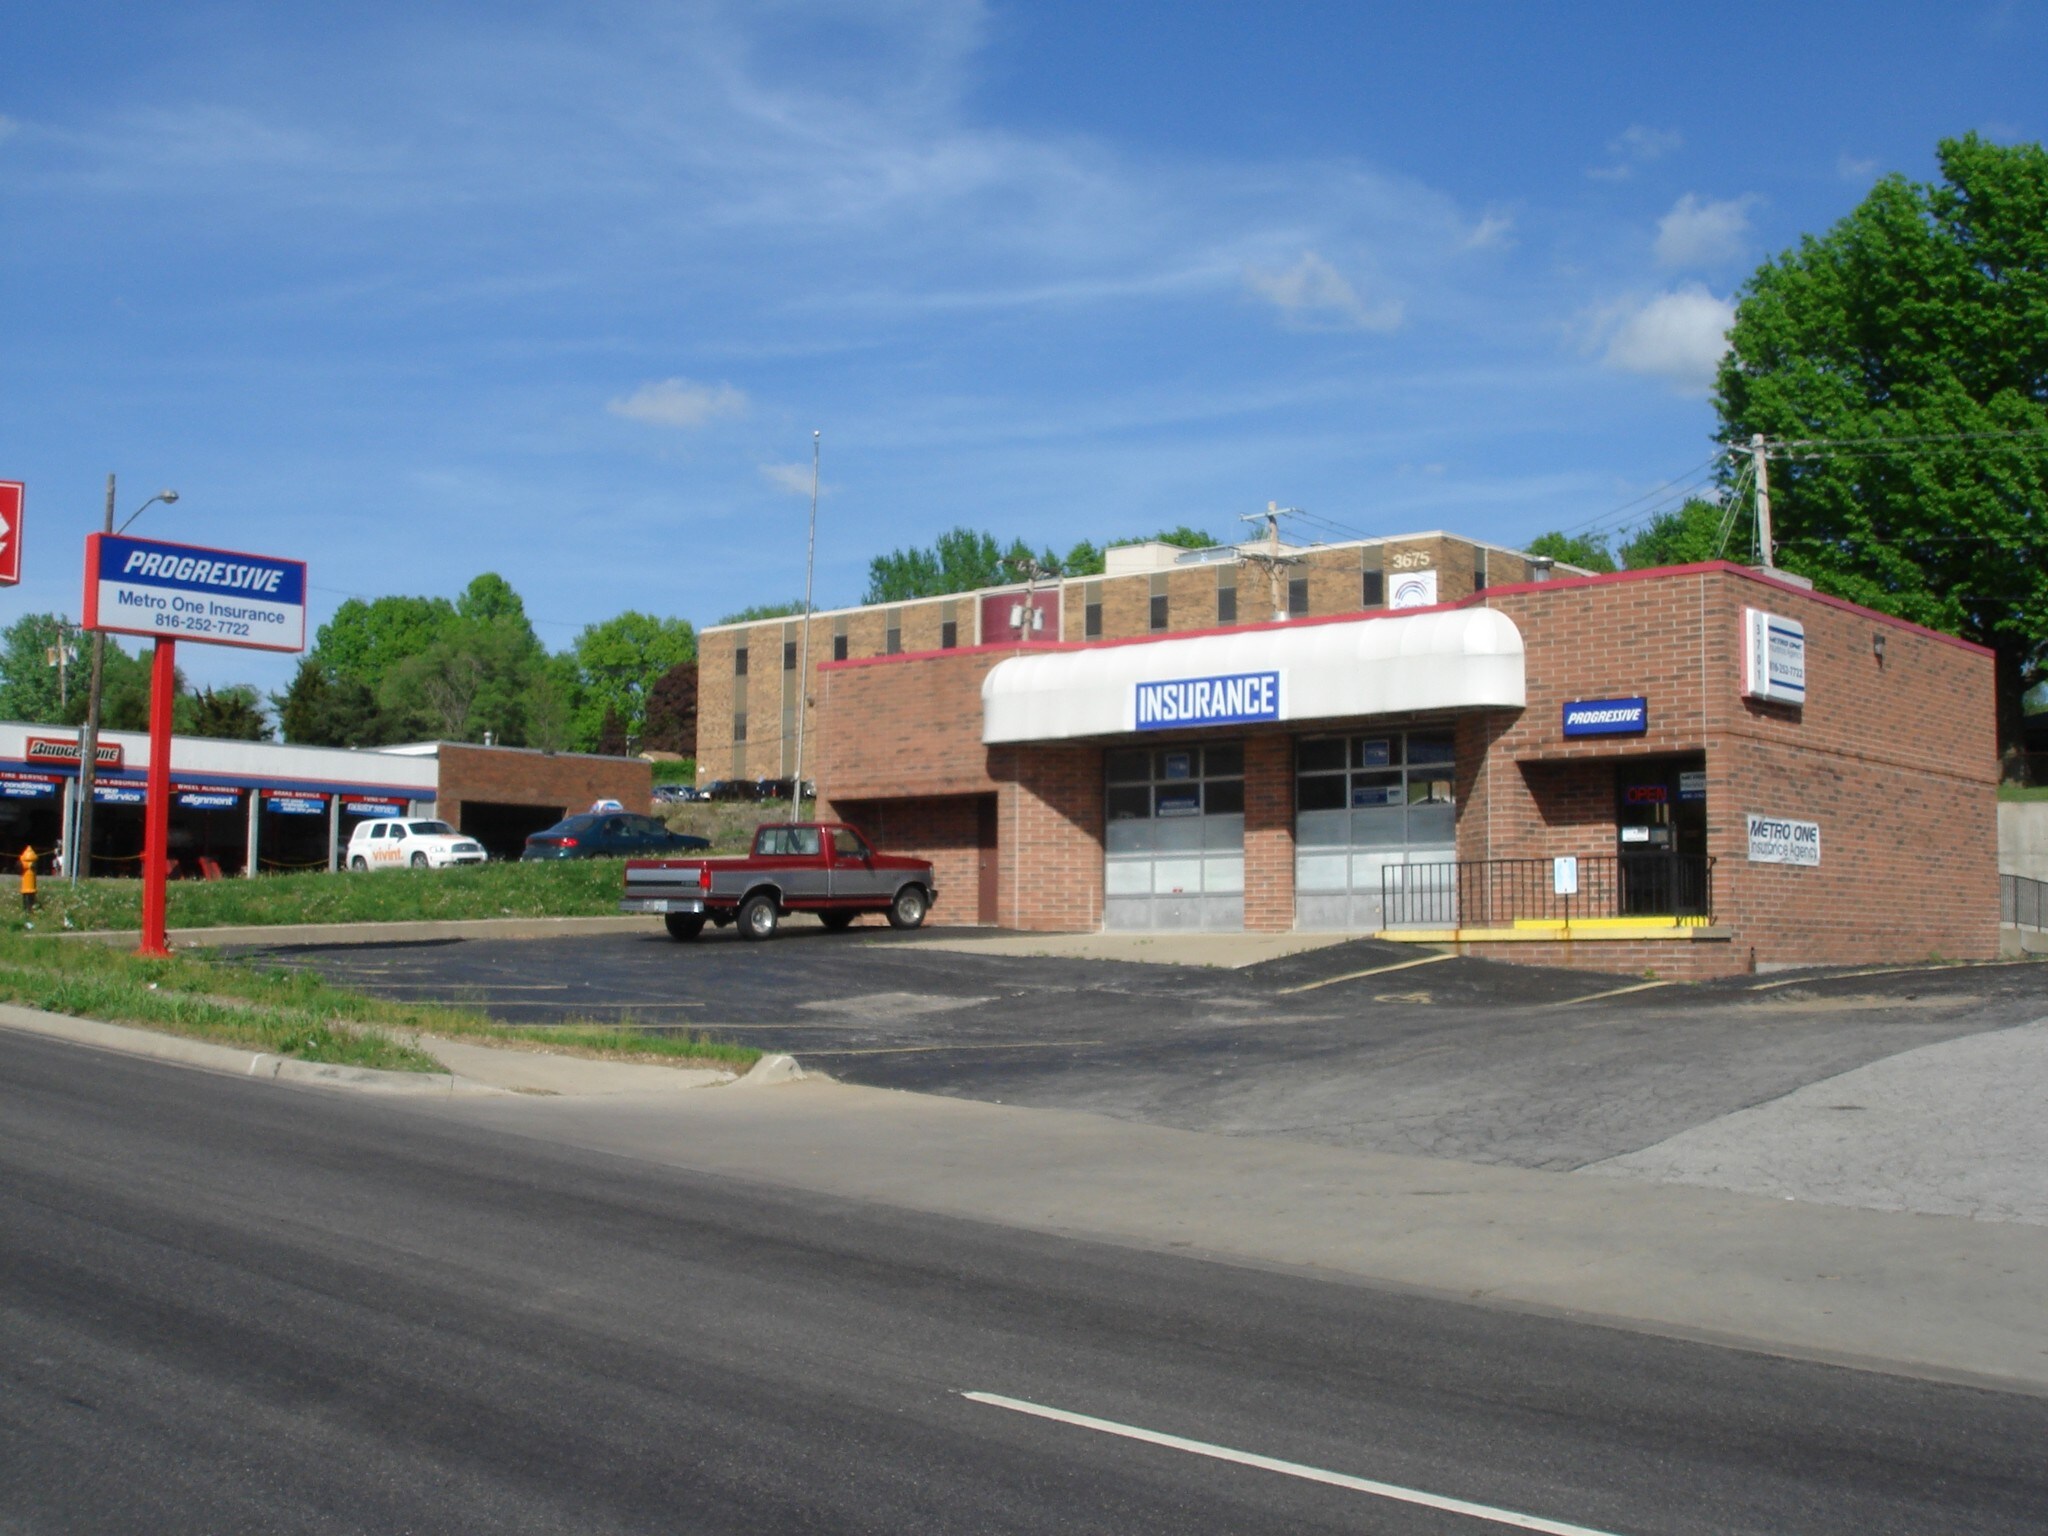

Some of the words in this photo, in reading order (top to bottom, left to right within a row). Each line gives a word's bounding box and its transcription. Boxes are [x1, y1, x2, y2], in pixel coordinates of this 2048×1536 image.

[1392, 551, 1430, 568] 3675
[123, 550, 284, 593] PROGRESSIVE
[118, 590, 167, 610] Metro
[172, 596, 205, 613] One
[209, 601, 285, 624] Insurance
[155, 613, 250, 636] 816-252-7722
[1139, 676, 1275, 722] INSURANCE
[1567, 708, 1642, 725] PROGRESSIVE
[31, 740, 119, 762] BRIDGENE
[104, 792, 141, 801] service
[181, 793, 233, 806] alignment
[1627, 787, 1667, 802] OPEN
[1750, 820, 1791, 840] METRO
[1794, 825, 1817, 842] ONE
